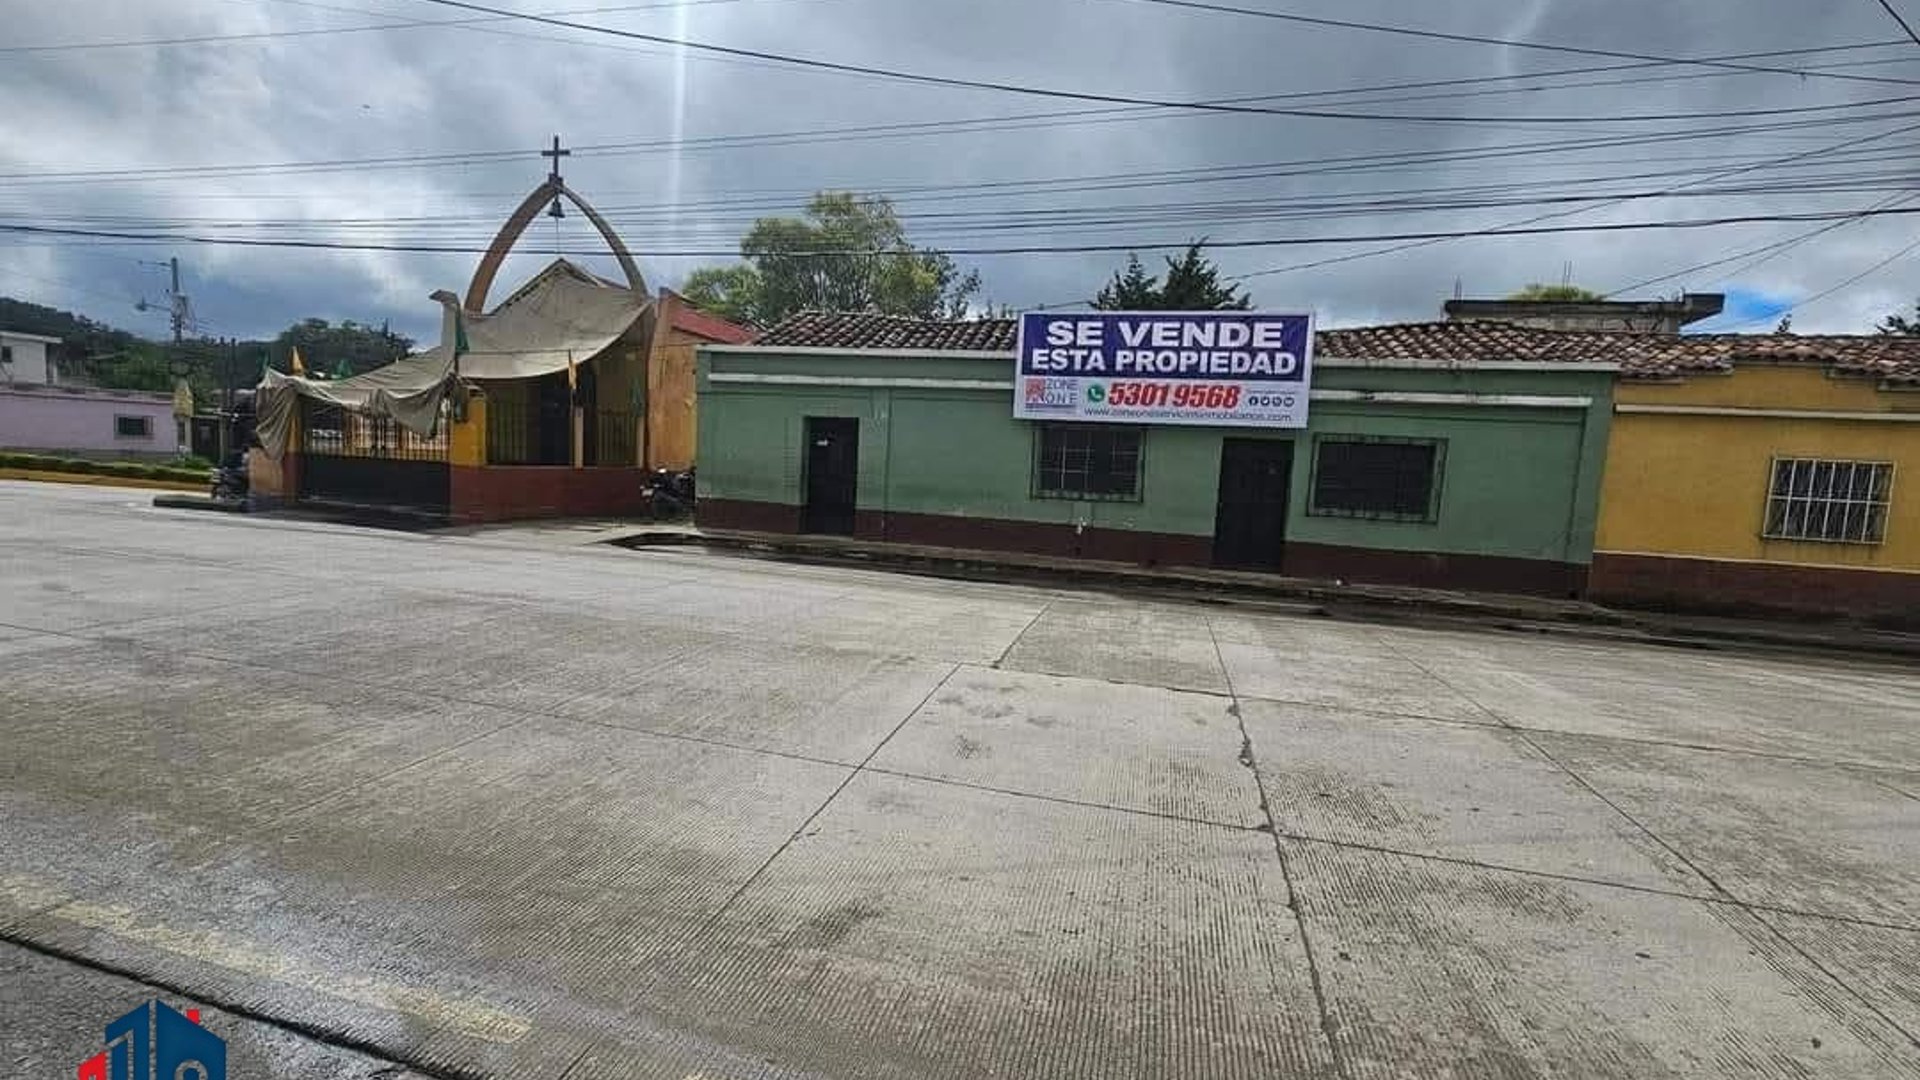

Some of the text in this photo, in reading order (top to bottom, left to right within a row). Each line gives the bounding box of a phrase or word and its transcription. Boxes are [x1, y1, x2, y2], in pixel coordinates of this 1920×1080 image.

[1047, 321, 1283, 349] SE VENDE
[1031, 349, 1297, 375] ESTA PROPIEDAD
[1044, 379, 1078, 391] ZONE
[1108, 382, 1241, 409] 5301 9568
[1045, 392, 1078, 405] ONE
